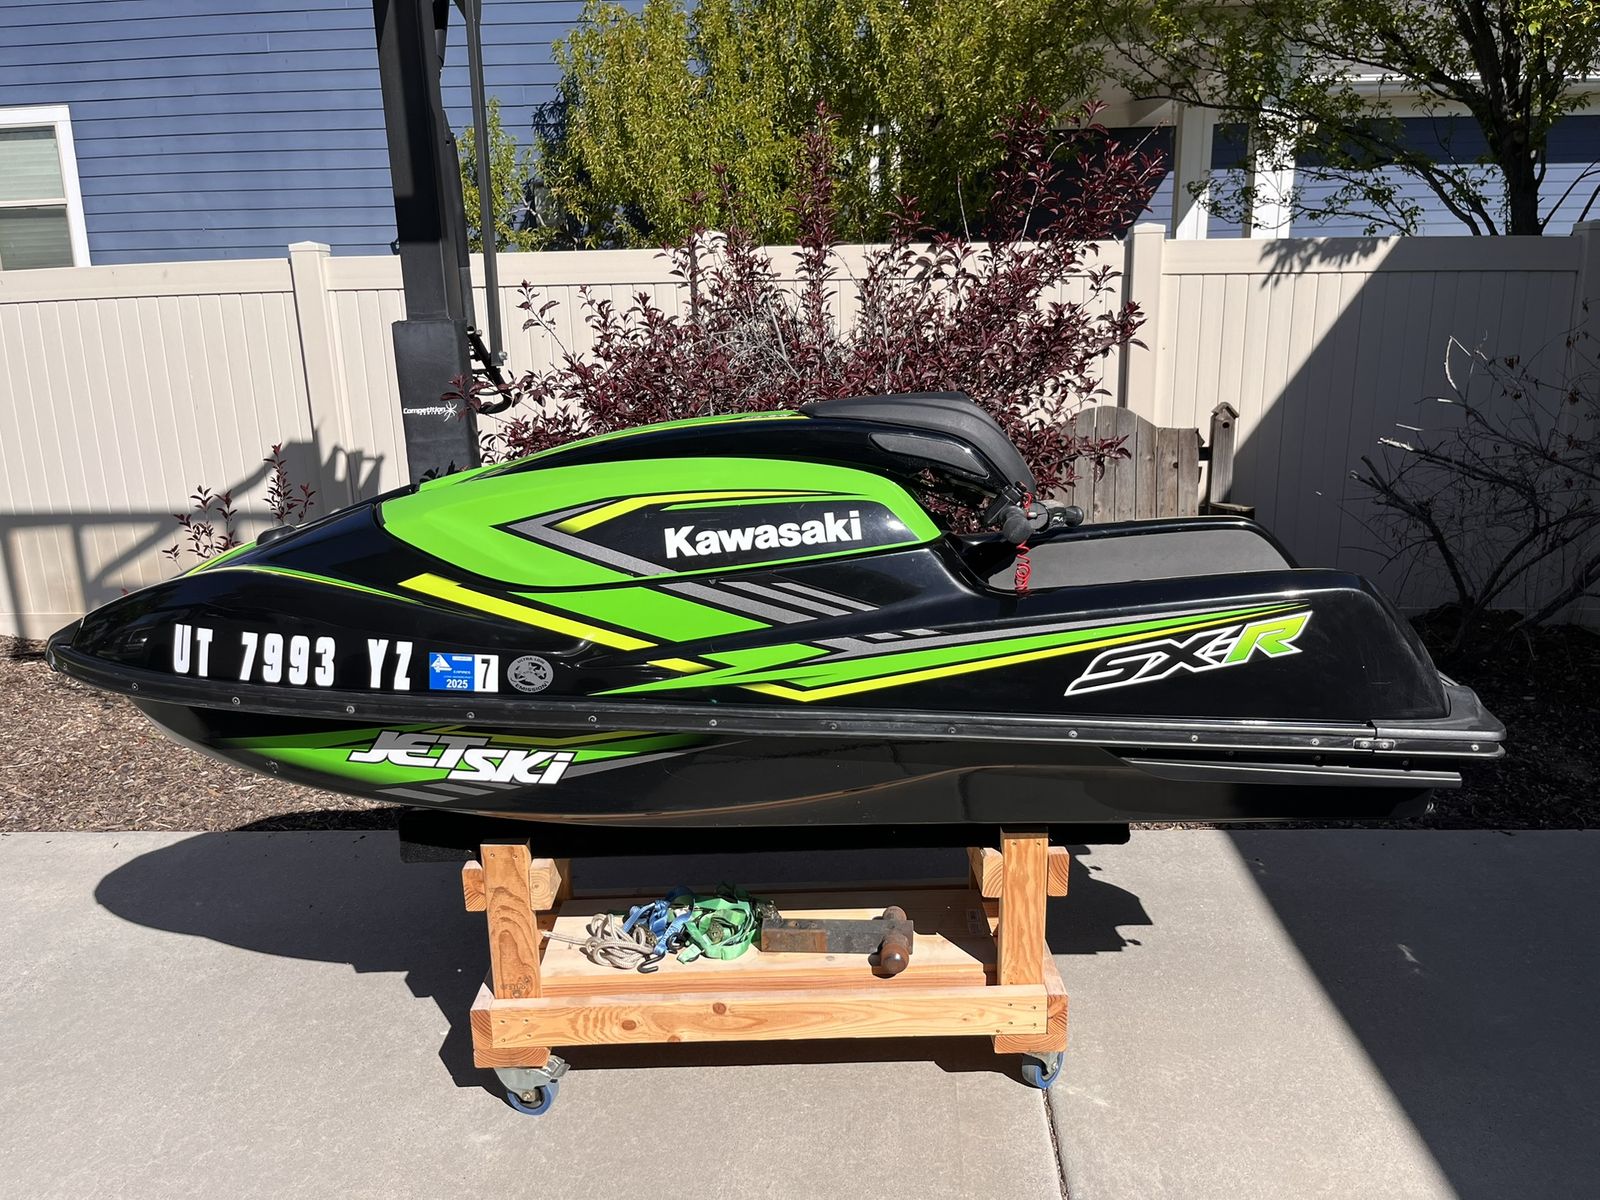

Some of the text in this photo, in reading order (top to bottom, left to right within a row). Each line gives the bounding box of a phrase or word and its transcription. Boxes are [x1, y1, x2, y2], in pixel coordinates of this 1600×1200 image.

[663, 510, 863, 559] Kawasaki
[173, 623, 413, 691] UT 7993 YZ
[481, 658, 491, 689] 7
[446, 678, 469, 689] 2025
